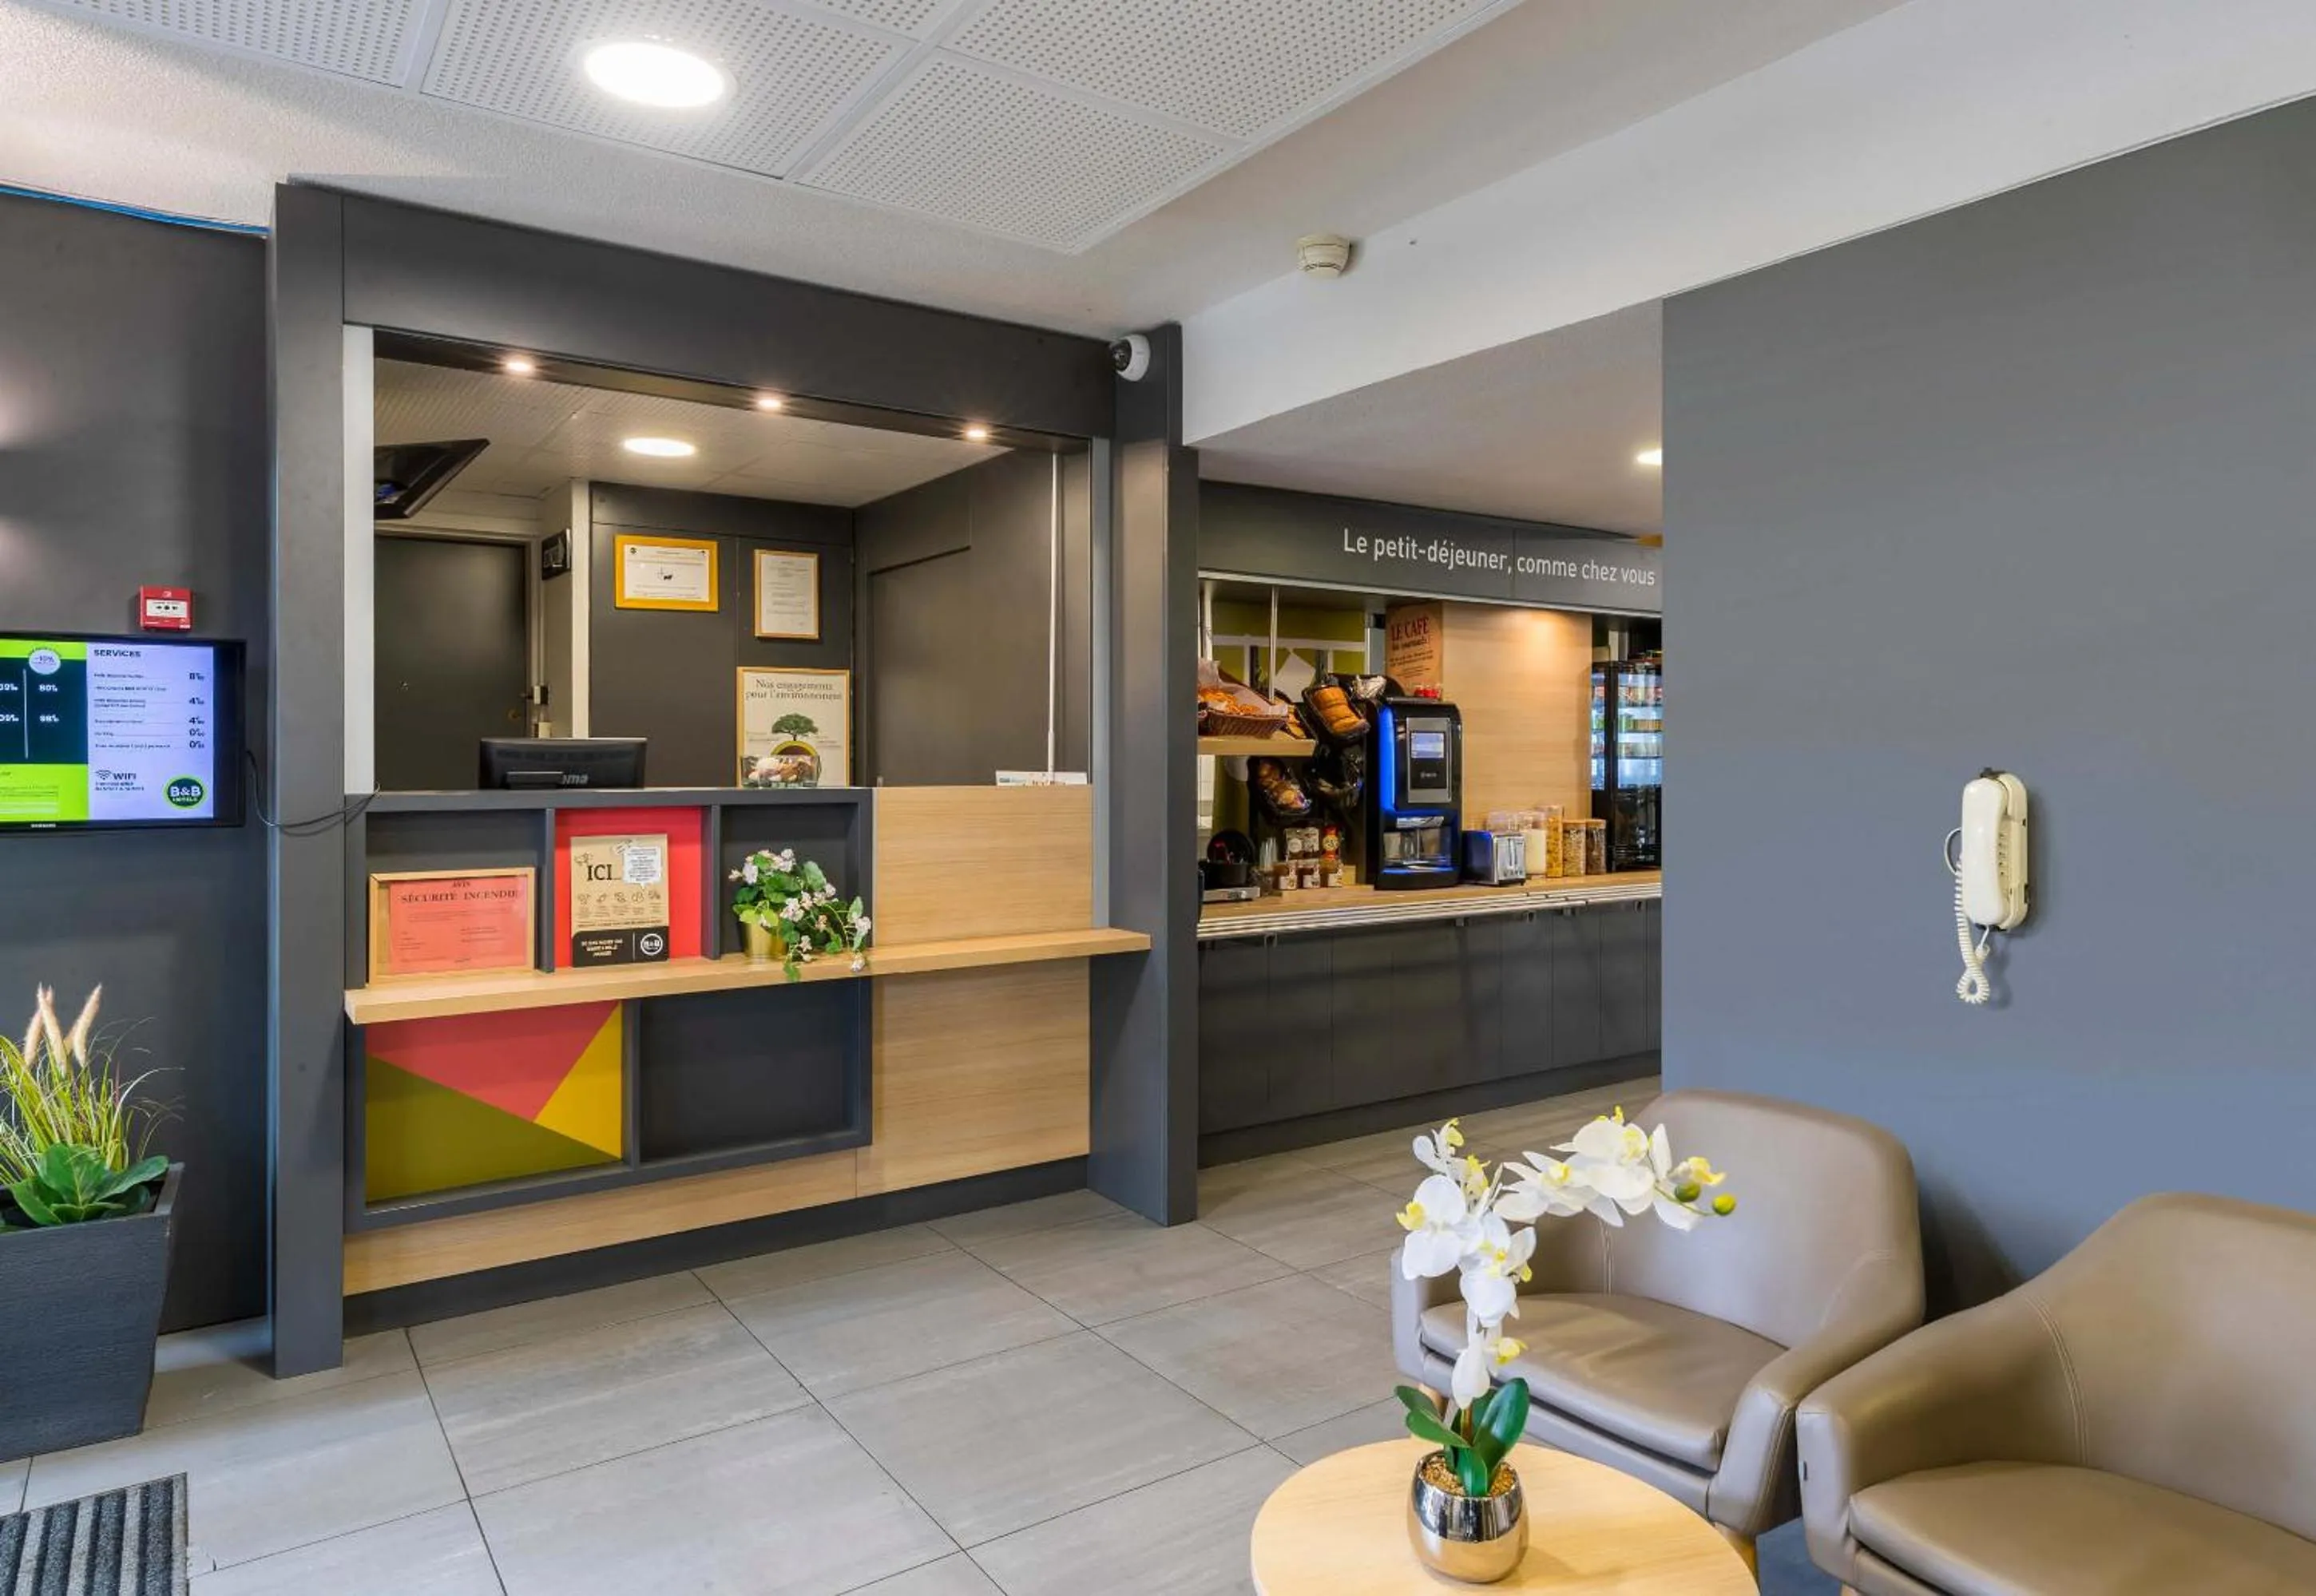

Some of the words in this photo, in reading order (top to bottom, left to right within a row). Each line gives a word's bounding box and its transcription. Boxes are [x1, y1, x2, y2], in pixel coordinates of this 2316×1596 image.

[1343, 528, 1367, 553] Le
[1374, 536, 1512, 575] petit-déjeuner,
[1517, 556, 1578, 578] comme
[1581, 560, 1617, 582] chez
[1620, 568, 1656, 587] vous
[93, 648, 142, 658] SERVICES
[755, 679, 775, 689] Nos
[169, 786, 201, 797] B&B
